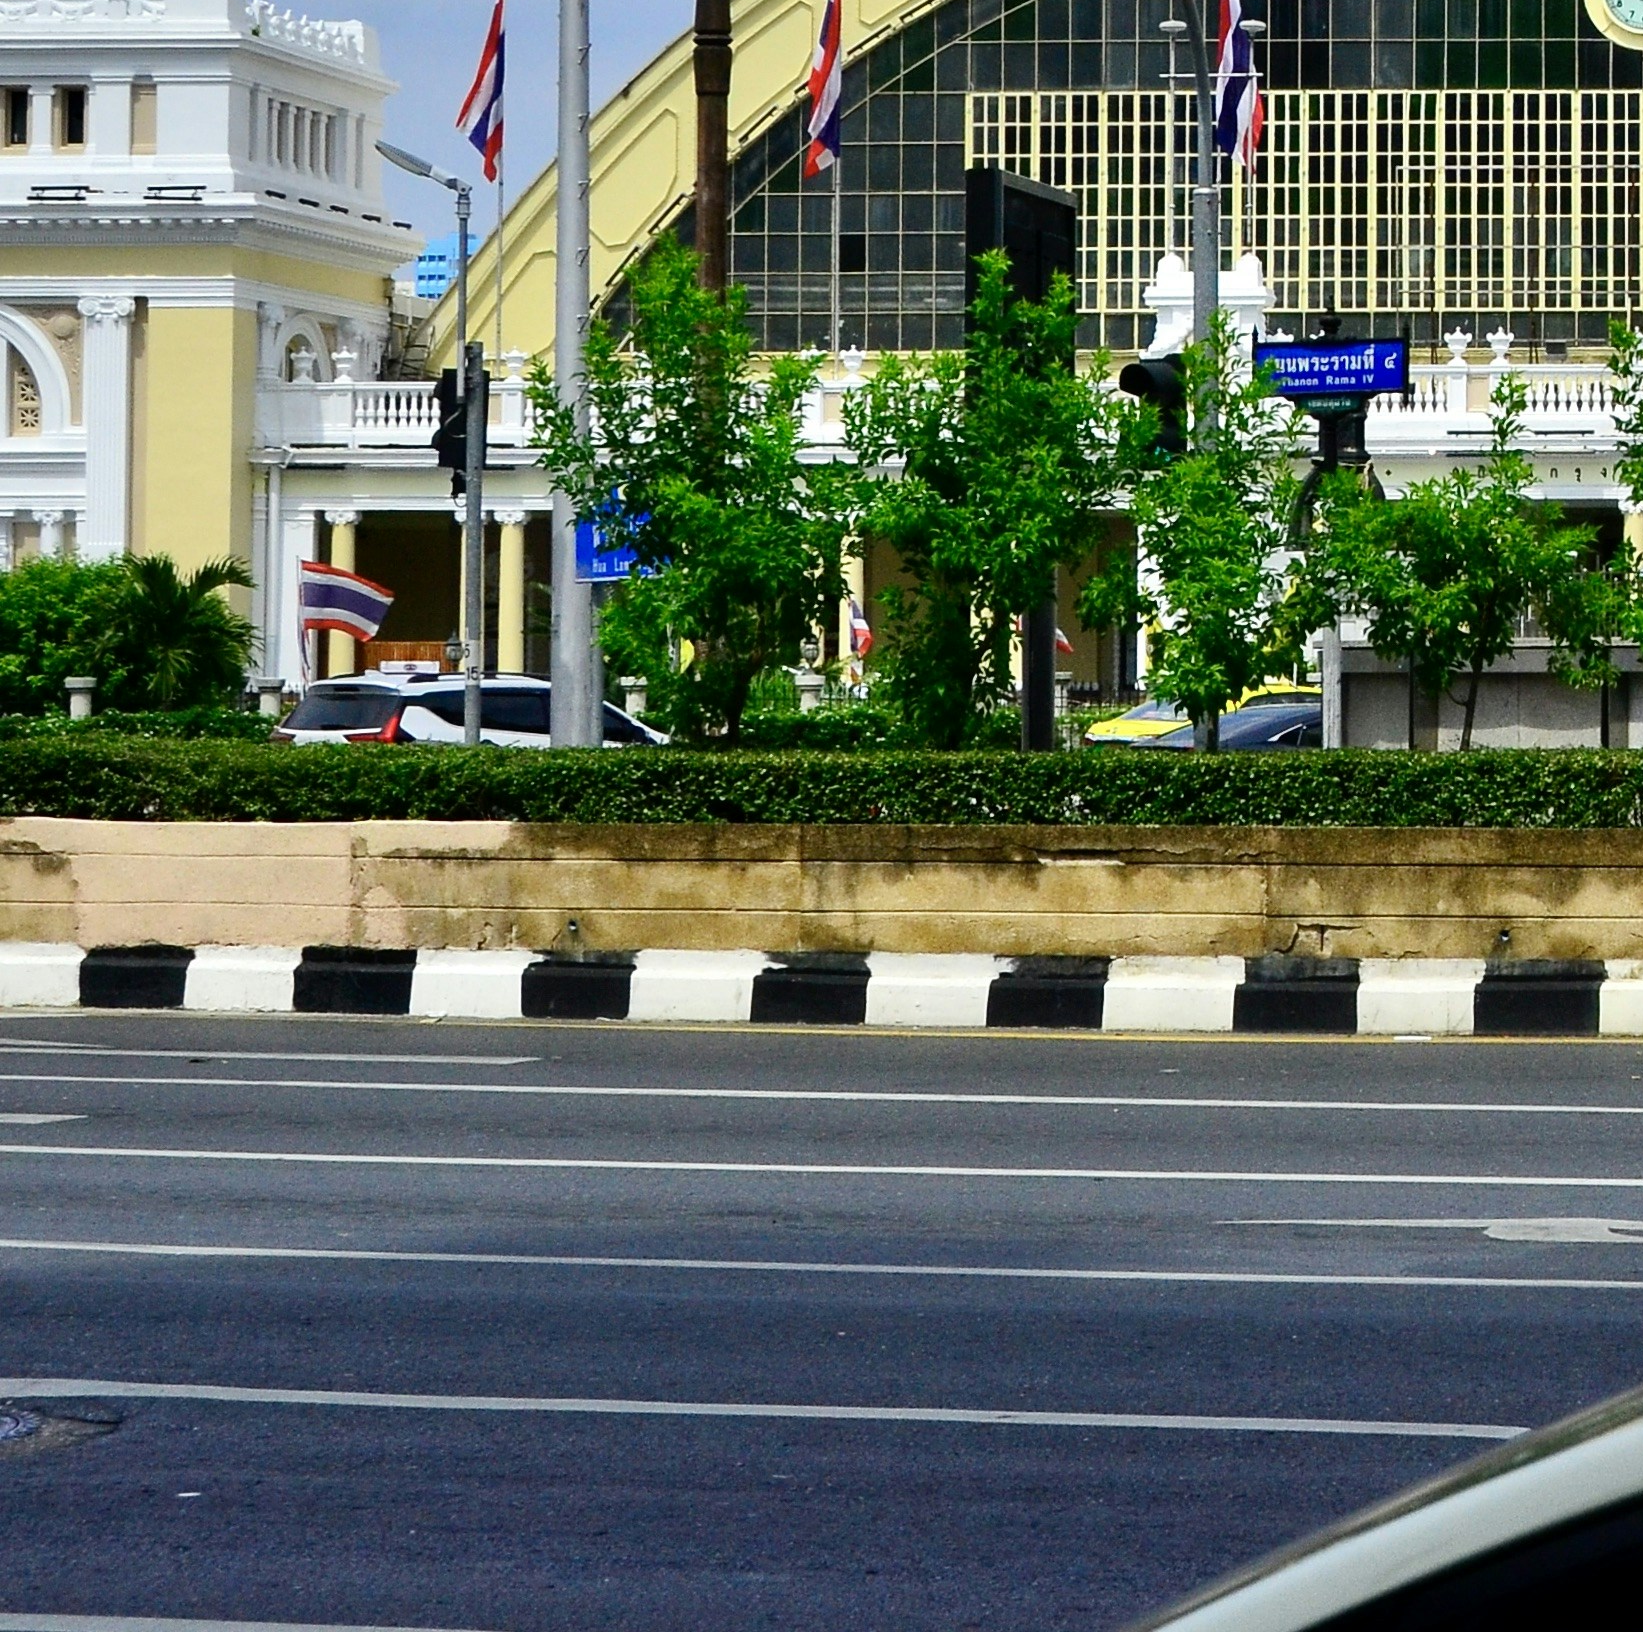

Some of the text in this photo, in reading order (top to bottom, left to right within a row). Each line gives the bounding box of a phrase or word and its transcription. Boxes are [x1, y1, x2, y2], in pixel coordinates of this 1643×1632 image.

[1383, 352, 1398, 370] ๔
[1325, 374, 1356, 386] Rama
[1362, 374, 1375, 384] IV
[466, 666, 479, 681] 15
